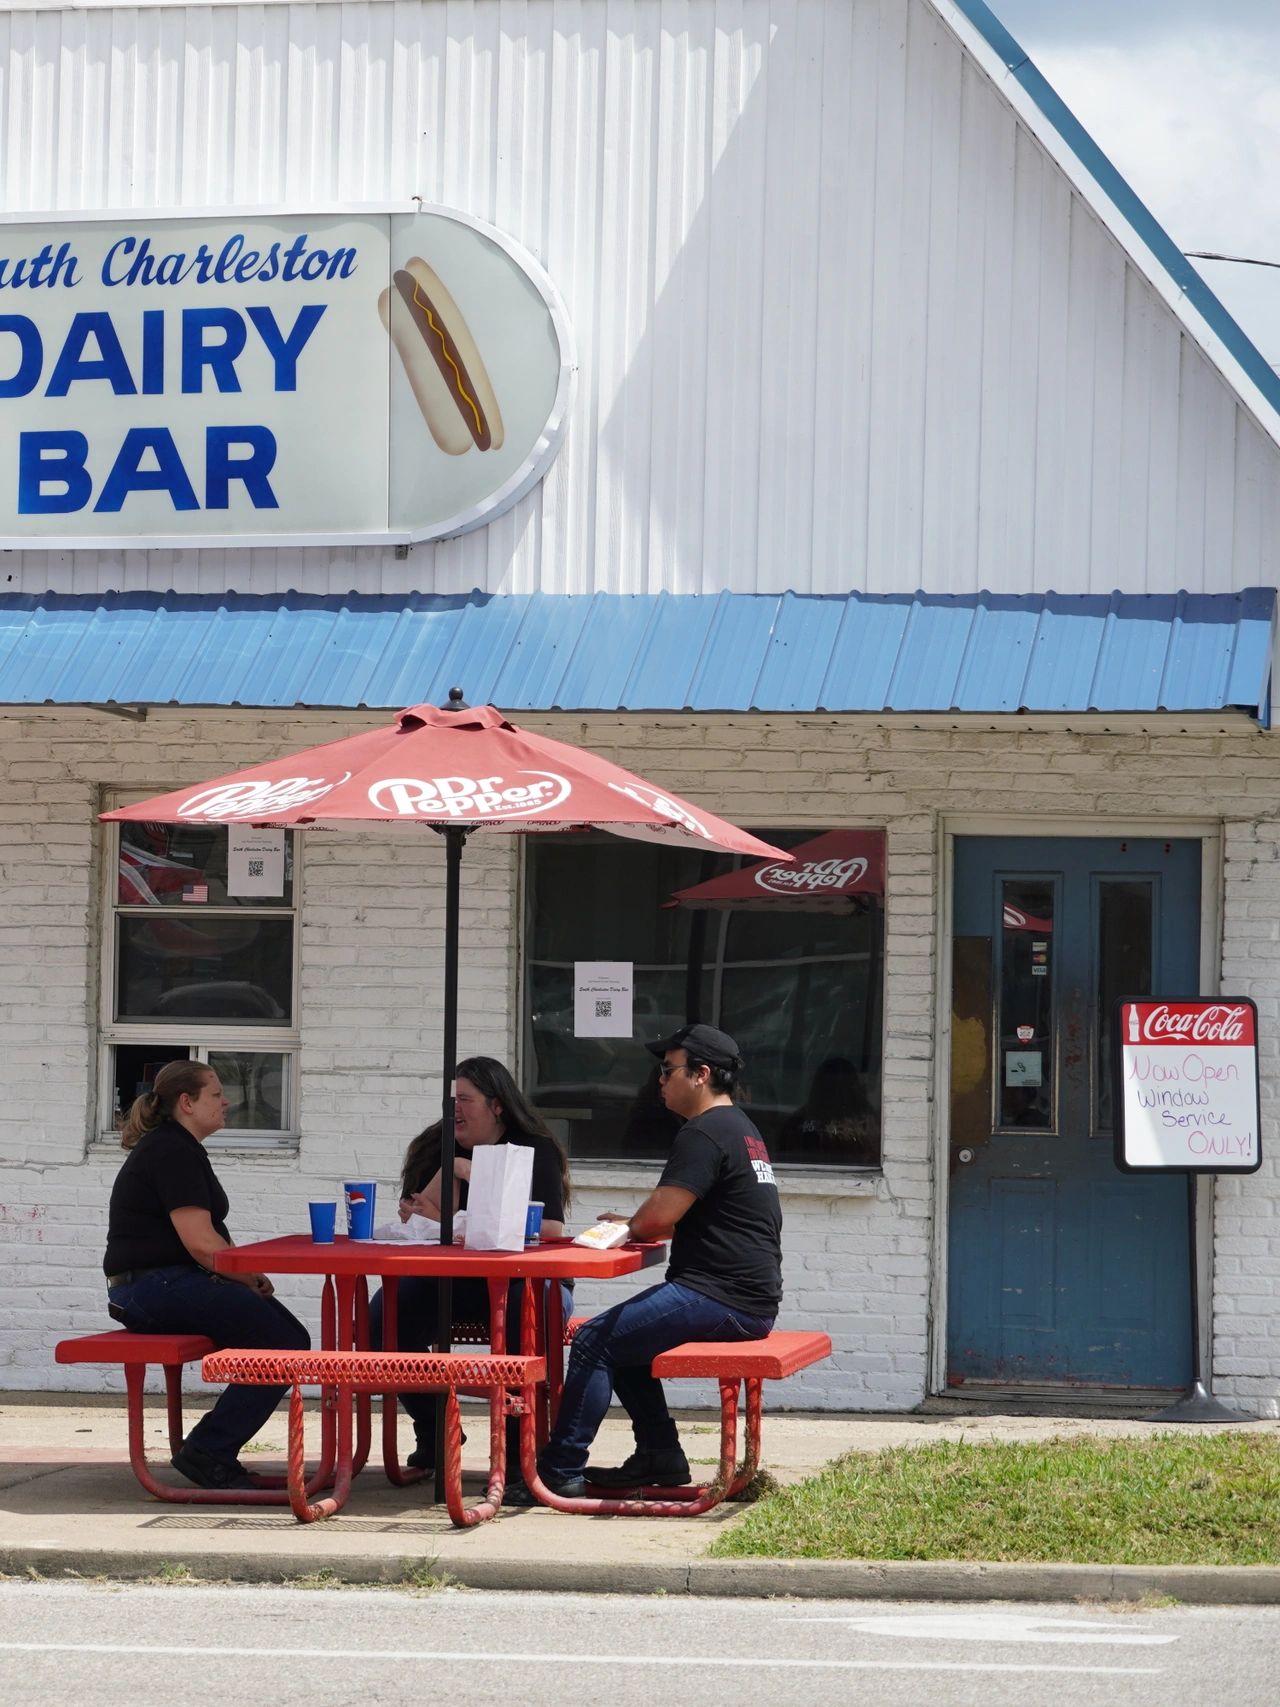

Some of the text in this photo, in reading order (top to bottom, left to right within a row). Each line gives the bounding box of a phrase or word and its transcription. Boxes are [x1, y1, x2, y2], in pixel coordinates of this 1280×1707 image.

[101, 233, 359, 288] Charleston
[18, 425, 280, 515] BAR
[431, 776, 504, 798] Dr
[1144, 1005, 1247, 1041] Coca-Cola
[1129, 1053, 1239, 1088] Now Open
[1161, 1109, 1232, 1128] Service
[1188, 1130, 1252, 1157] ONLY!
